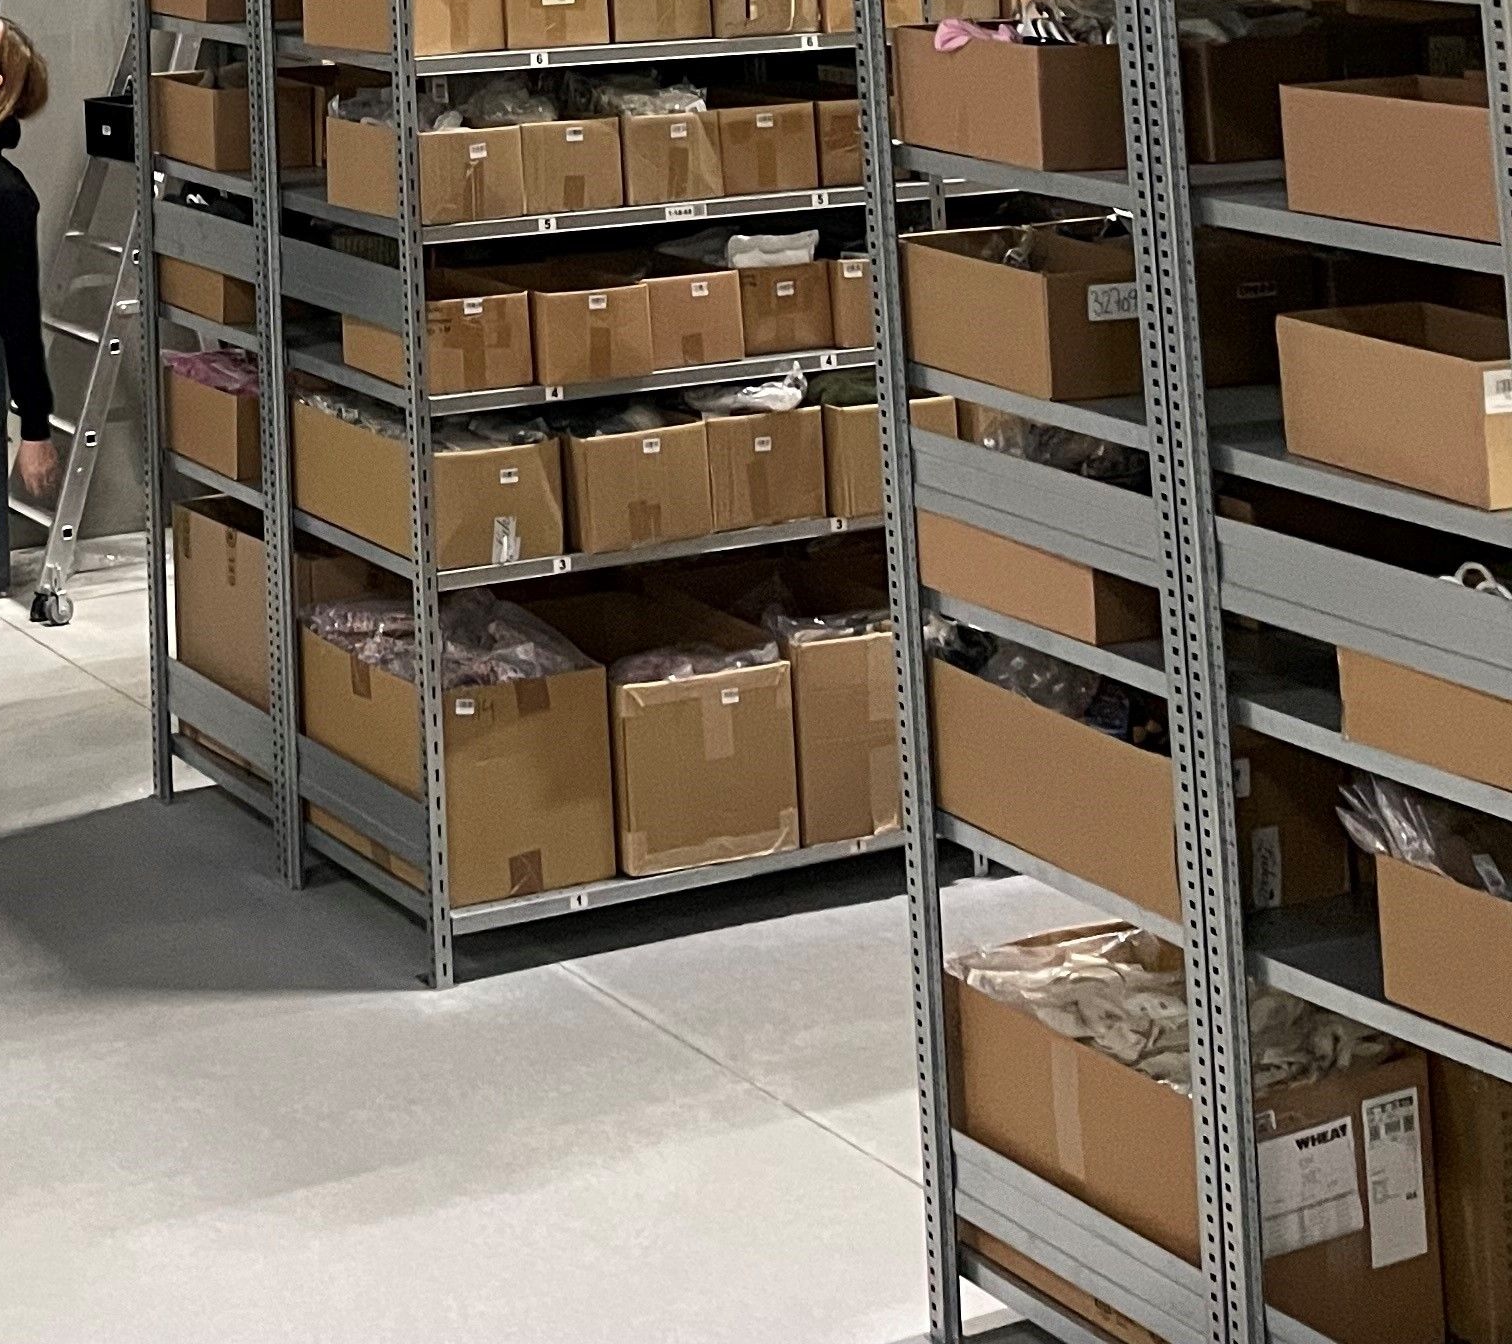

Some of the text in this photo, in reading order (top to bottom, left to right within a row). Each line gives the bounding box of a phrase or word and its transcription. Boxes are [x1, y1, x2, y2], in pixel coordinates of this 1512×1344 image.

[536, 54, 543, 64] 6
[544, 219, 551, 229] 5
[826, 355, 832, 365] 4
[551, 387, 558, 397] 4
[836, 519, 842, 529] 3
[559, 559, 566, 570] 3
